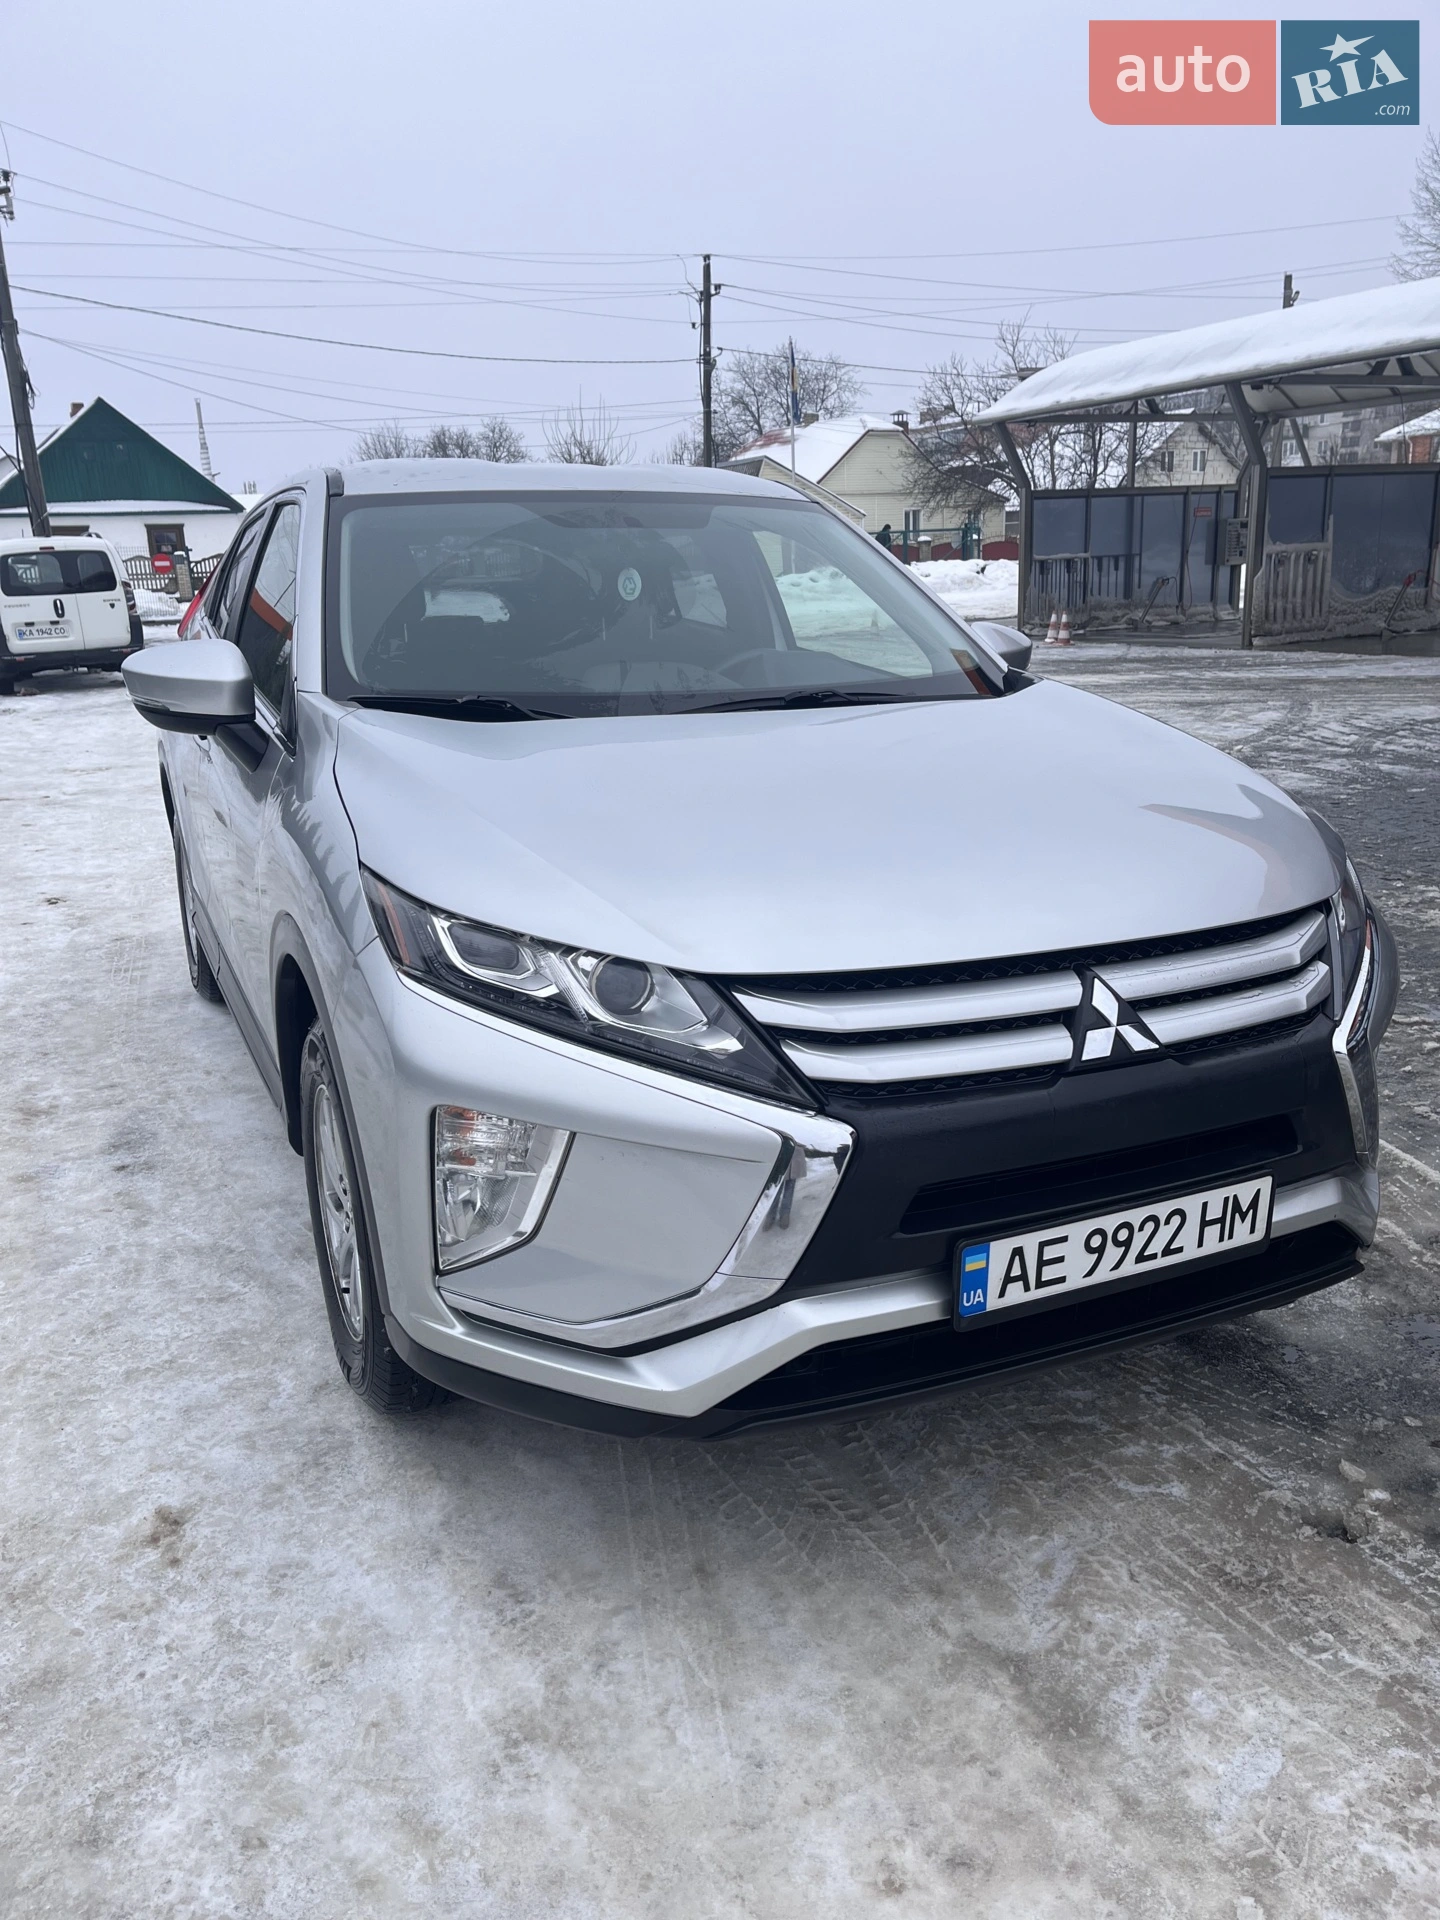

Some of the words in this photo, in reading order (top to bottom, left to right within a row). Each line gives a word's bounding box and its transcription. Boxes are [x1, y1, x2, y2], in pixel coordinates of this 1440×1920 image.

[36, 627, 53, 636] 1942
[997, 1234, 1069, 1299] AE
[1082, 1207, 1187, 1279] 9922
[1196, 1187, 1262, 1249] HM
[962, 1288, 985, 1307] UA
